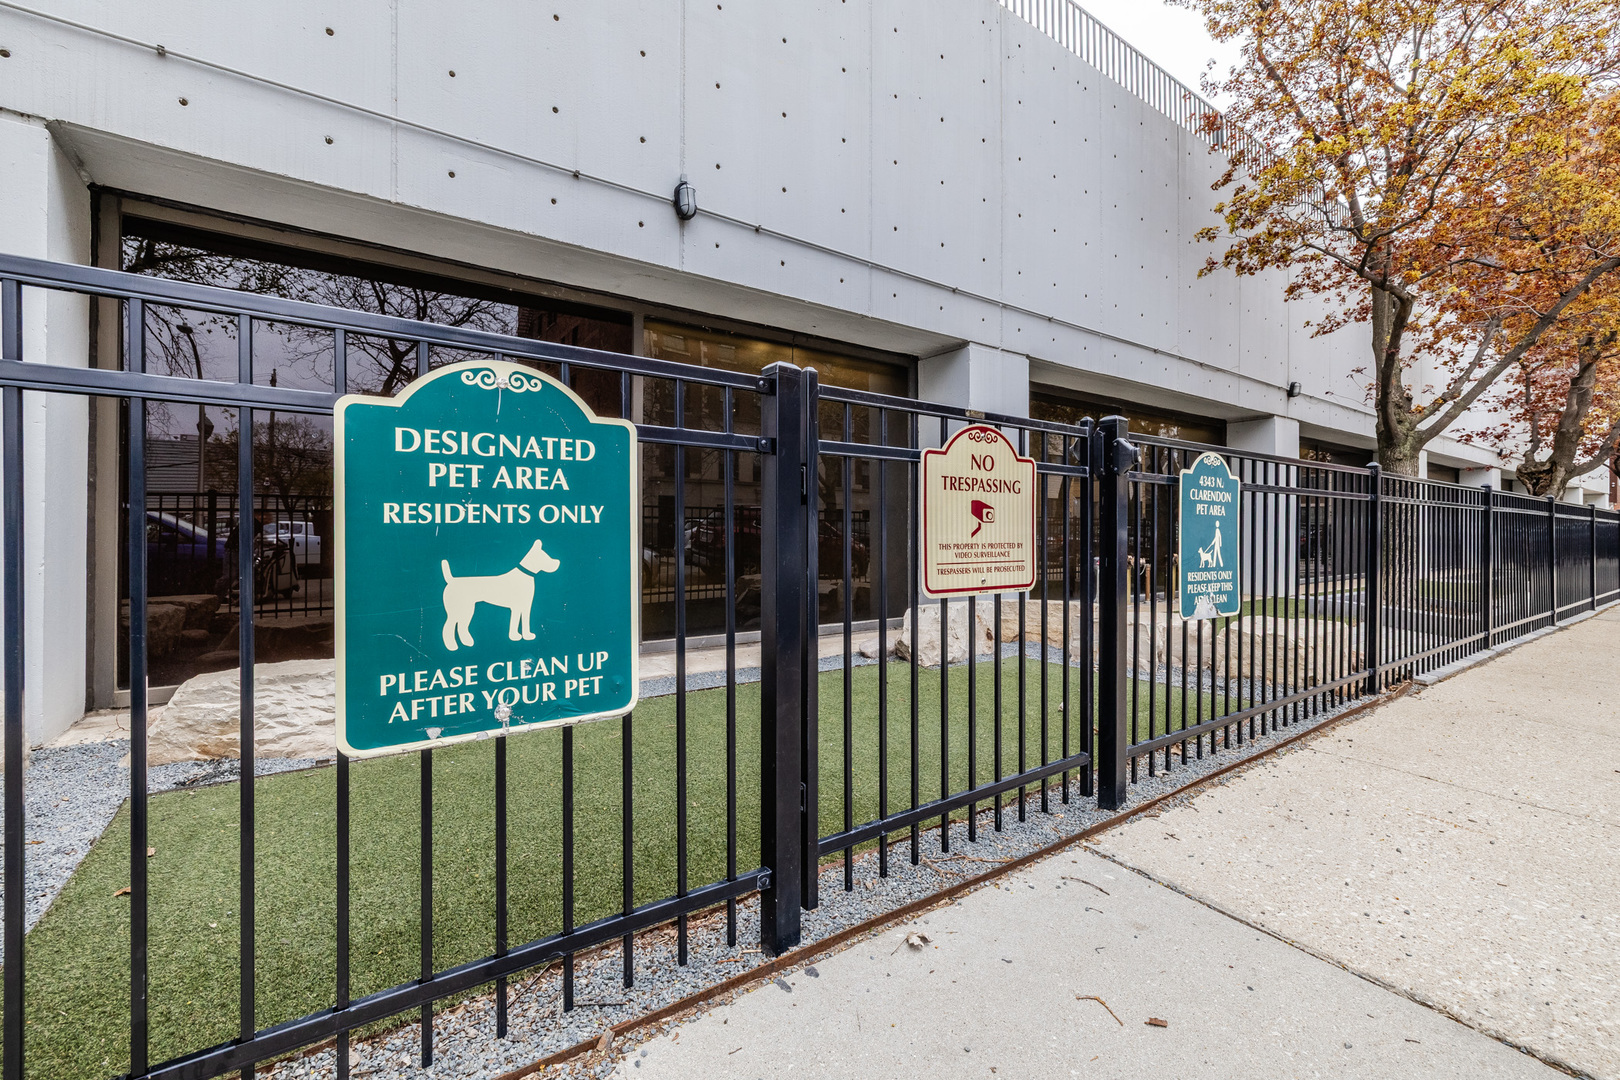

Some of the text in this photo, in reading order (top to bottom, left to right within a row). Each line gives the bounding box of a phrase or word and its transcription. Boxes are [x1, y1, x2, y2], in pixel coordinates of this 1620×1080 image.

[394, 427, 596, 462] DESIGNATED
[971, 453, 995, 472] NO
[428, 463, 570, 491] PET AREA
[1199, 475, 1215, 488] 4343
[941, 476, 1021, 494] TRESPASSING
[1190, 488, 1231, 503] CLARENDON
[383, 502, 604, 524] RESIDENTS ONLY
[1196, 503, 1226, 516] PET AREA
[954, 551, 972, 559] VIDEO
[937, 567, 971, 575] TRESPASSERS
[994, 565, 1025, 573] PROSECUTED
[1187, 571, 1232, 582] RESIDENTS ONLY
[1187, 582, 1233, 594] PLEASE KEEP THIS
[1210, 594, 1227, 604] LEAN
[379, 651, 609, 696] PLEASE CLEAN UP
[388, 676, 604, 724] AFTER YOUR PET
